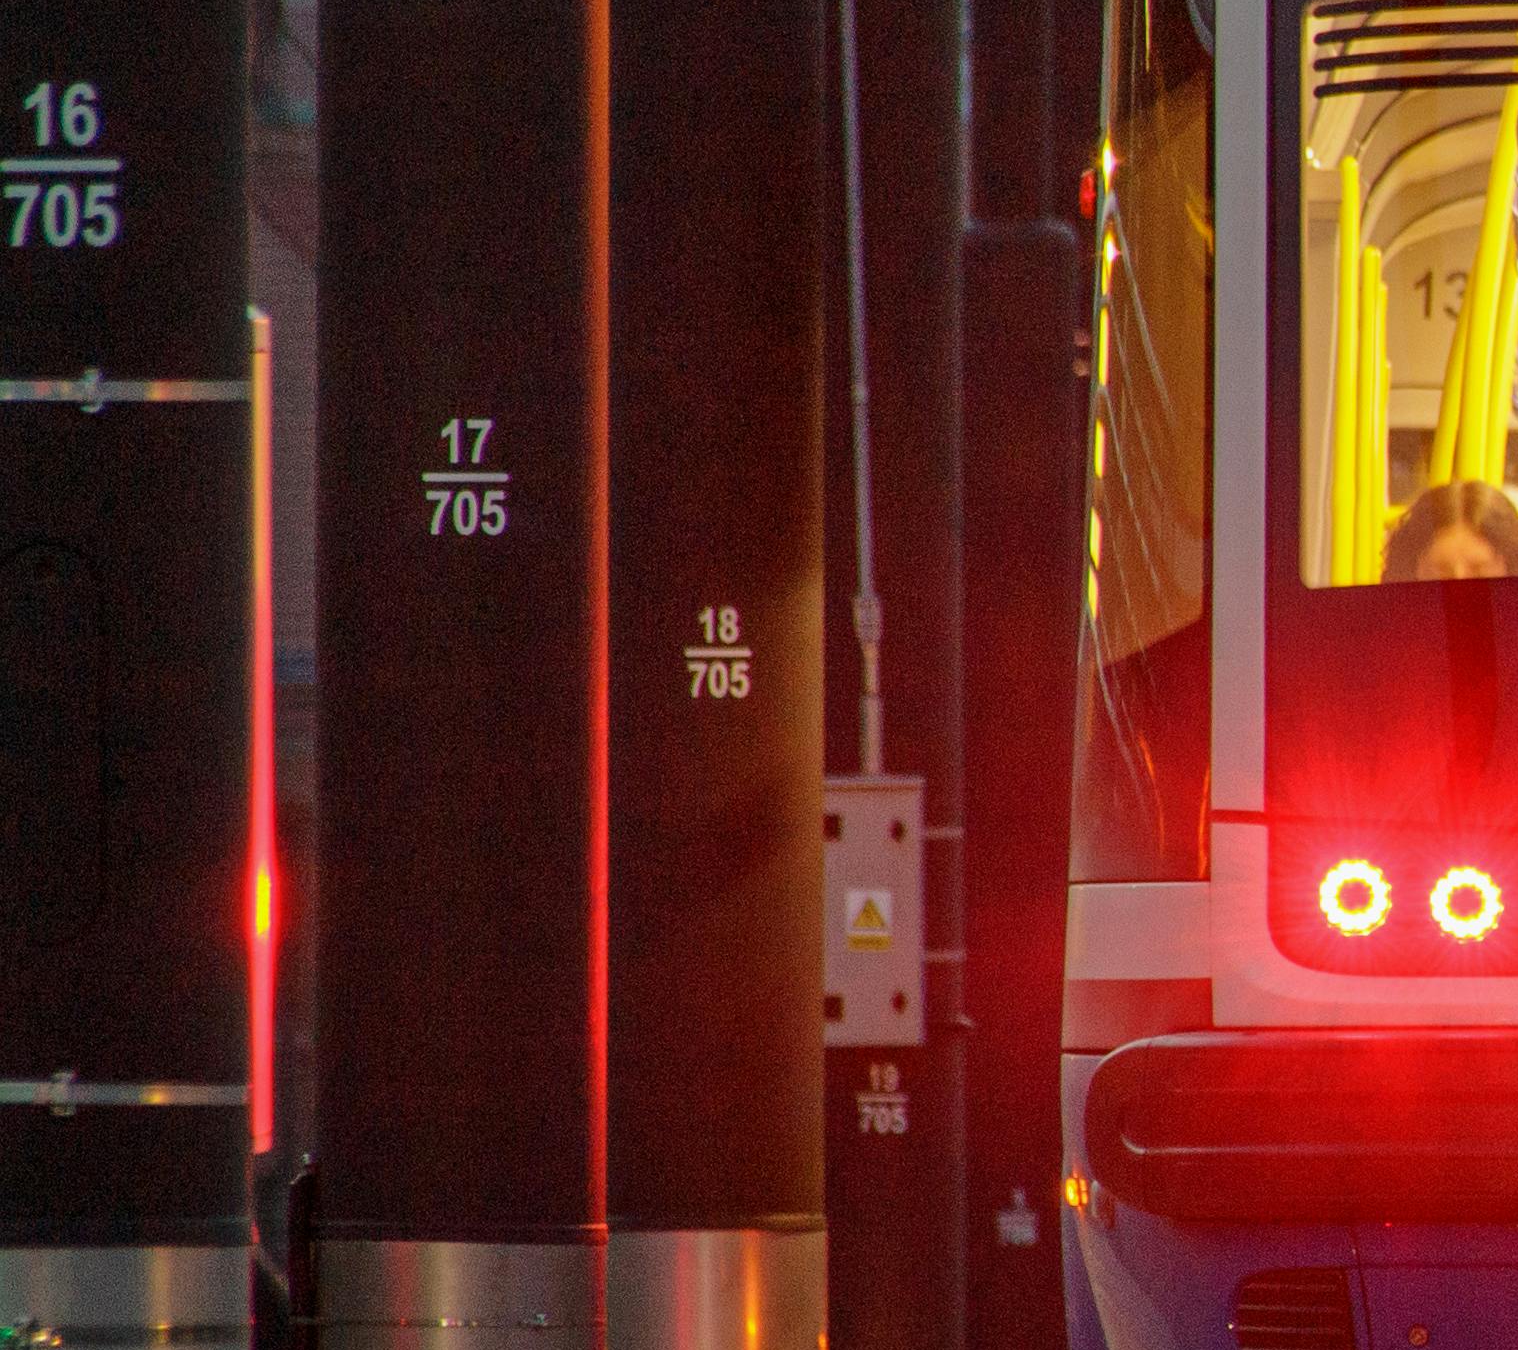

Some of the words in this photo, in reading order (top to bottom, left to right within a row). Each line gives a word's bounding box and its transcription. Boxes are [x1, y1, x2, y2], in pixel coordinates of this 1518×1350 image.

[24, 82, 98, 147] 16
[3, 183, 120, 248] 705
[440, 418, 493, 464] 17
[424, 490, 508, 536] 705
[698, 605, 741, 645] 18
[686, 661, 752, 700] 705
[869, 1063, 900, 1092] 19
[859, 1105, 910, 1135] 705
